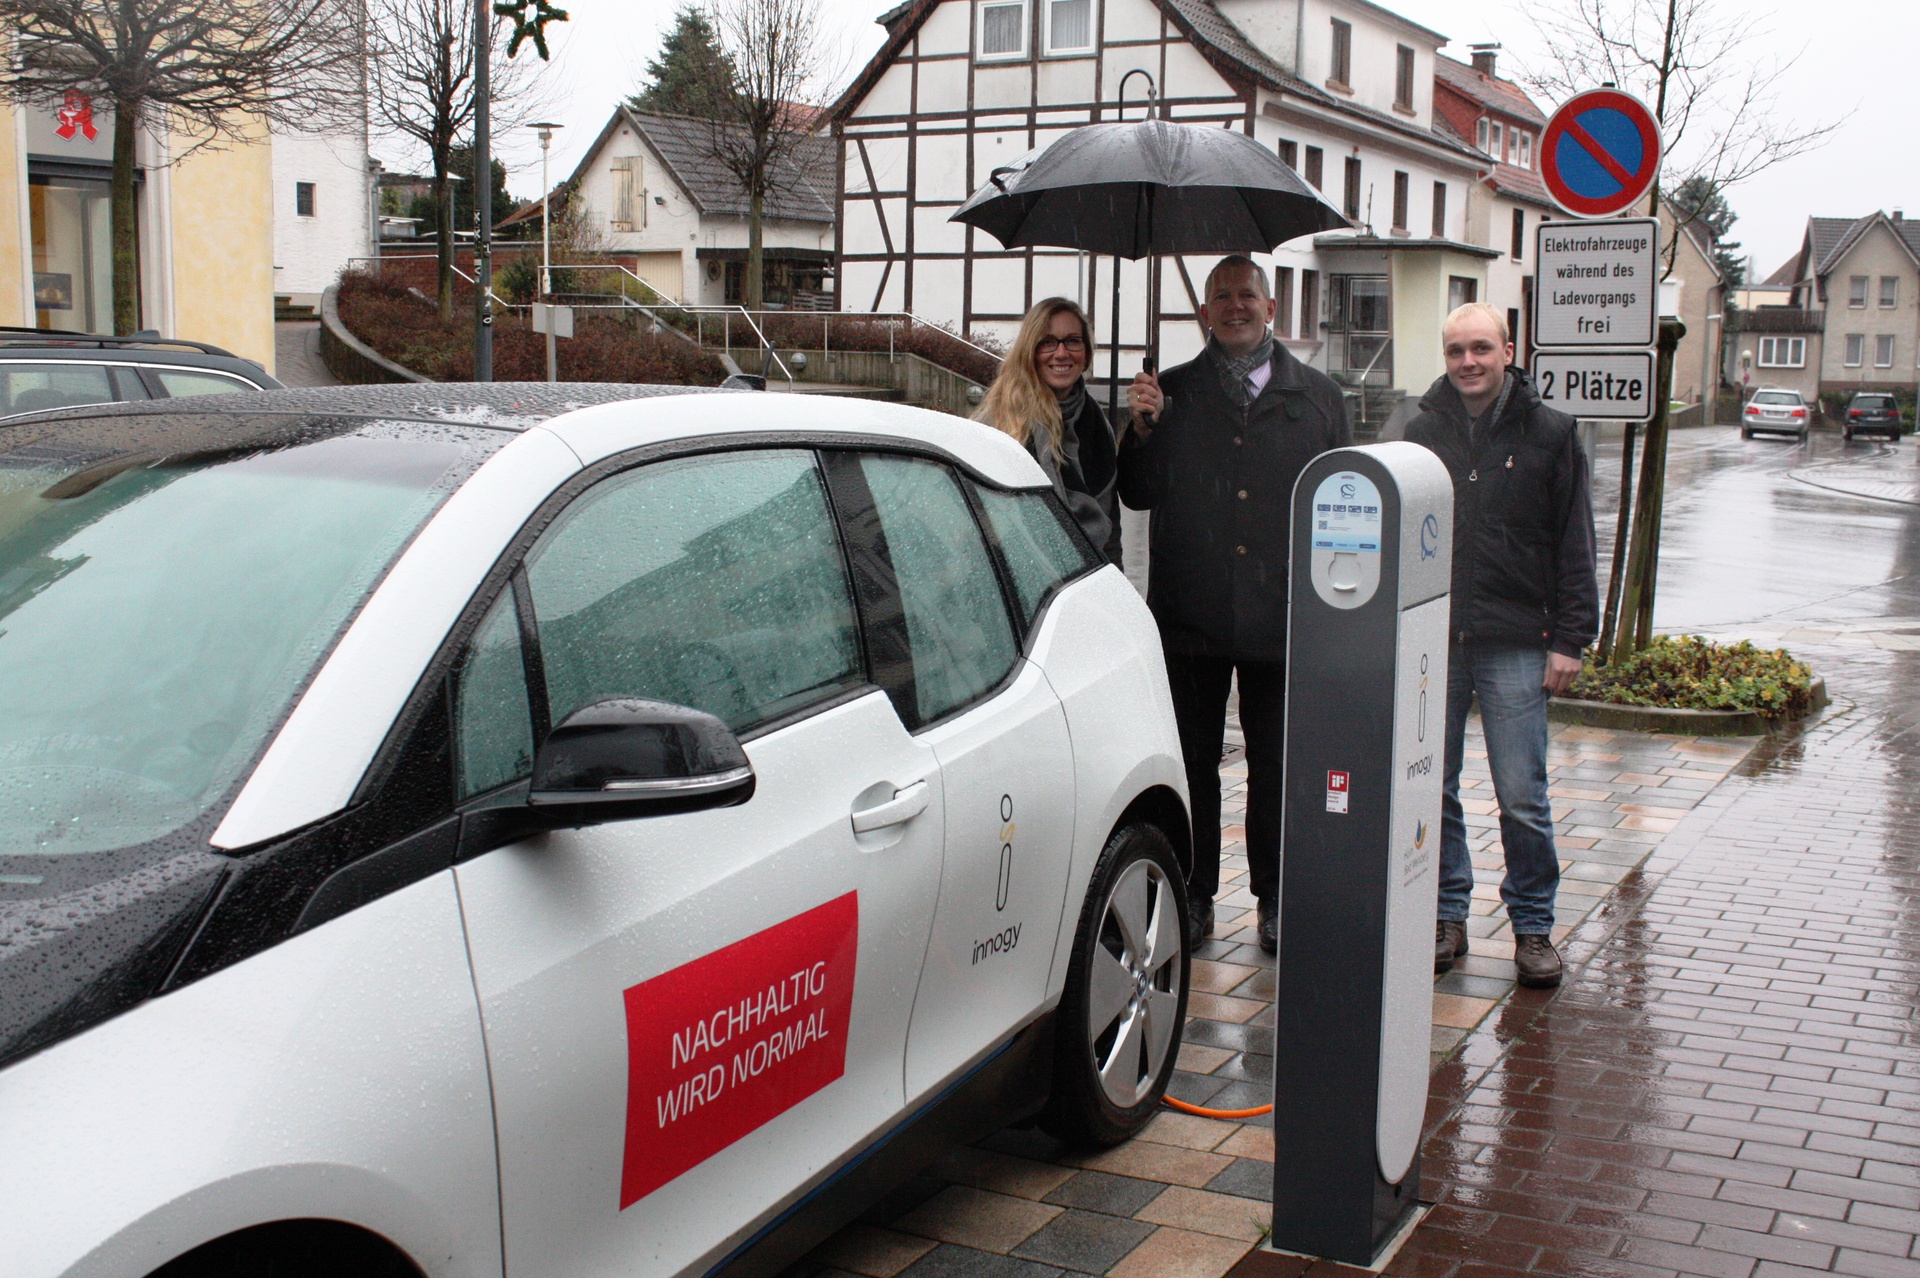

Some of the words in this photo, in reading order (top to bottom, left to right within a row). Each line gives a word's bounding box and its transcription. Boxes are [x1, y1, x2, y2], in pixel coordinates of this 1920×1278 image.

[1545, 238, 1647, 254] Elektrofahrzeuge
[1556, 263, 1607, 279] während
[1613, 262, 1634, 278] des
[1553, 290, 1636, 308] Ladevorgangs
[1577, 316, 1611, 334] frei
[1541, 370, 1555, 400] 2
[1565, 369, 1643, 401] Plätze
[1406, 753, 1433, 781] innogy
[972, 922, 1023, 966] innogy
[671, 961, 826, 1069] NACHHALTIG
[657, 1064, 725, 1129] WIRD
[731, 1007, 829, 1088] NORMAL
